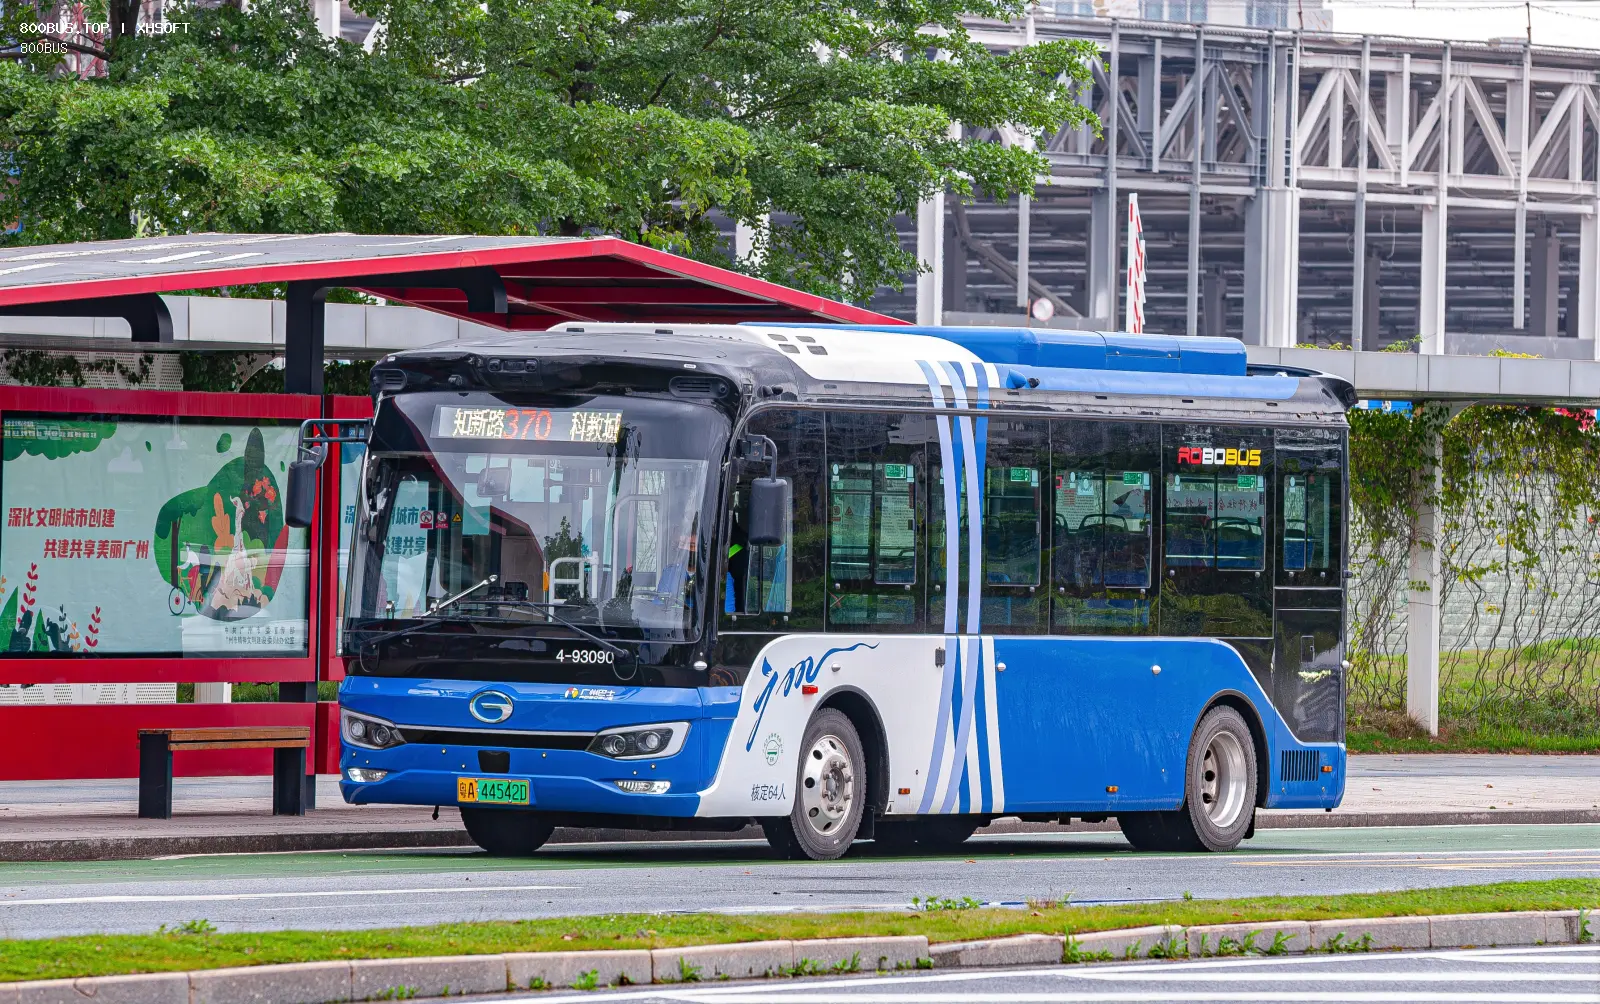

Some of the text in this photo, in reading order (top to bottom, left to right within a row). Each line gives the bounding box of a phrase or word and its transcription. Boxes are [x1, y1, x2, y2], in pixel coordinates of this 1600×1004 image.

[452, 407, 622, 443] 知新路 370 科教城
[1177, 447, 1262, 467] ROBOBUS
[8, 507, 116, 528] 深化文明城市创建
[43, 538, 150, 559] 共建共享美丽广州
[556, 649, 614, 664] 4-93090
[580, 689, 615, 697] 广州巴士
[460, 782, 527, 800] 粤A 44542D
[751, 783, 786, 801] 核定64人
